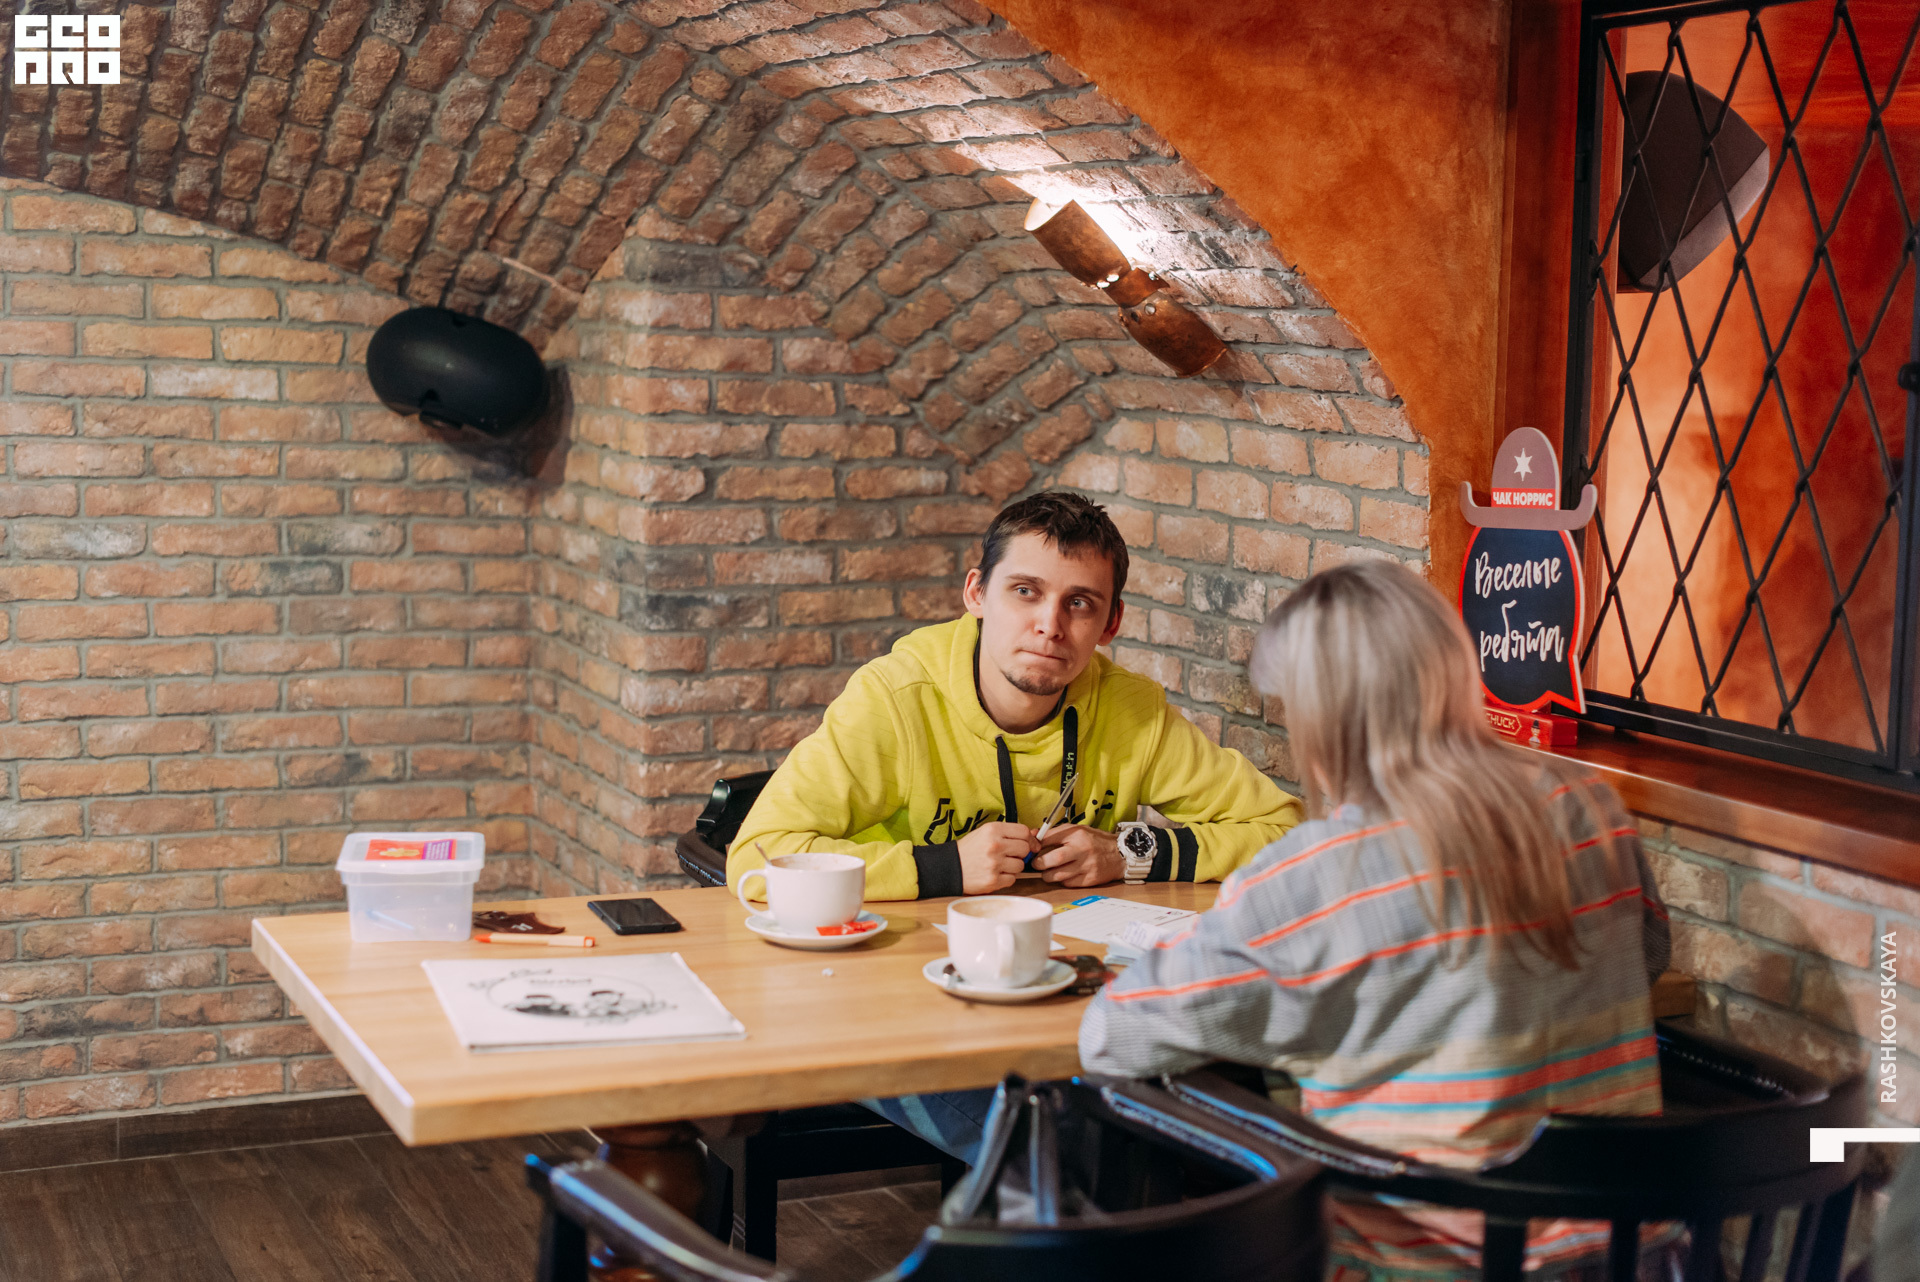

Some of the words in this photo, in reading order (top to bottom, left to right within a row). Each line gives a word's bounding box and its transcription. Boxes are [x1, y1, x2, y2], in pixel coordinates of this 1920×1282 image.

[1493, 492, 1511, 505] ЧАК
[1513, 492, 1553, 506] НОРРИС
[1475, 551, 1561, 598] Веселые
[1480, 600, 1564, 672] ребята
